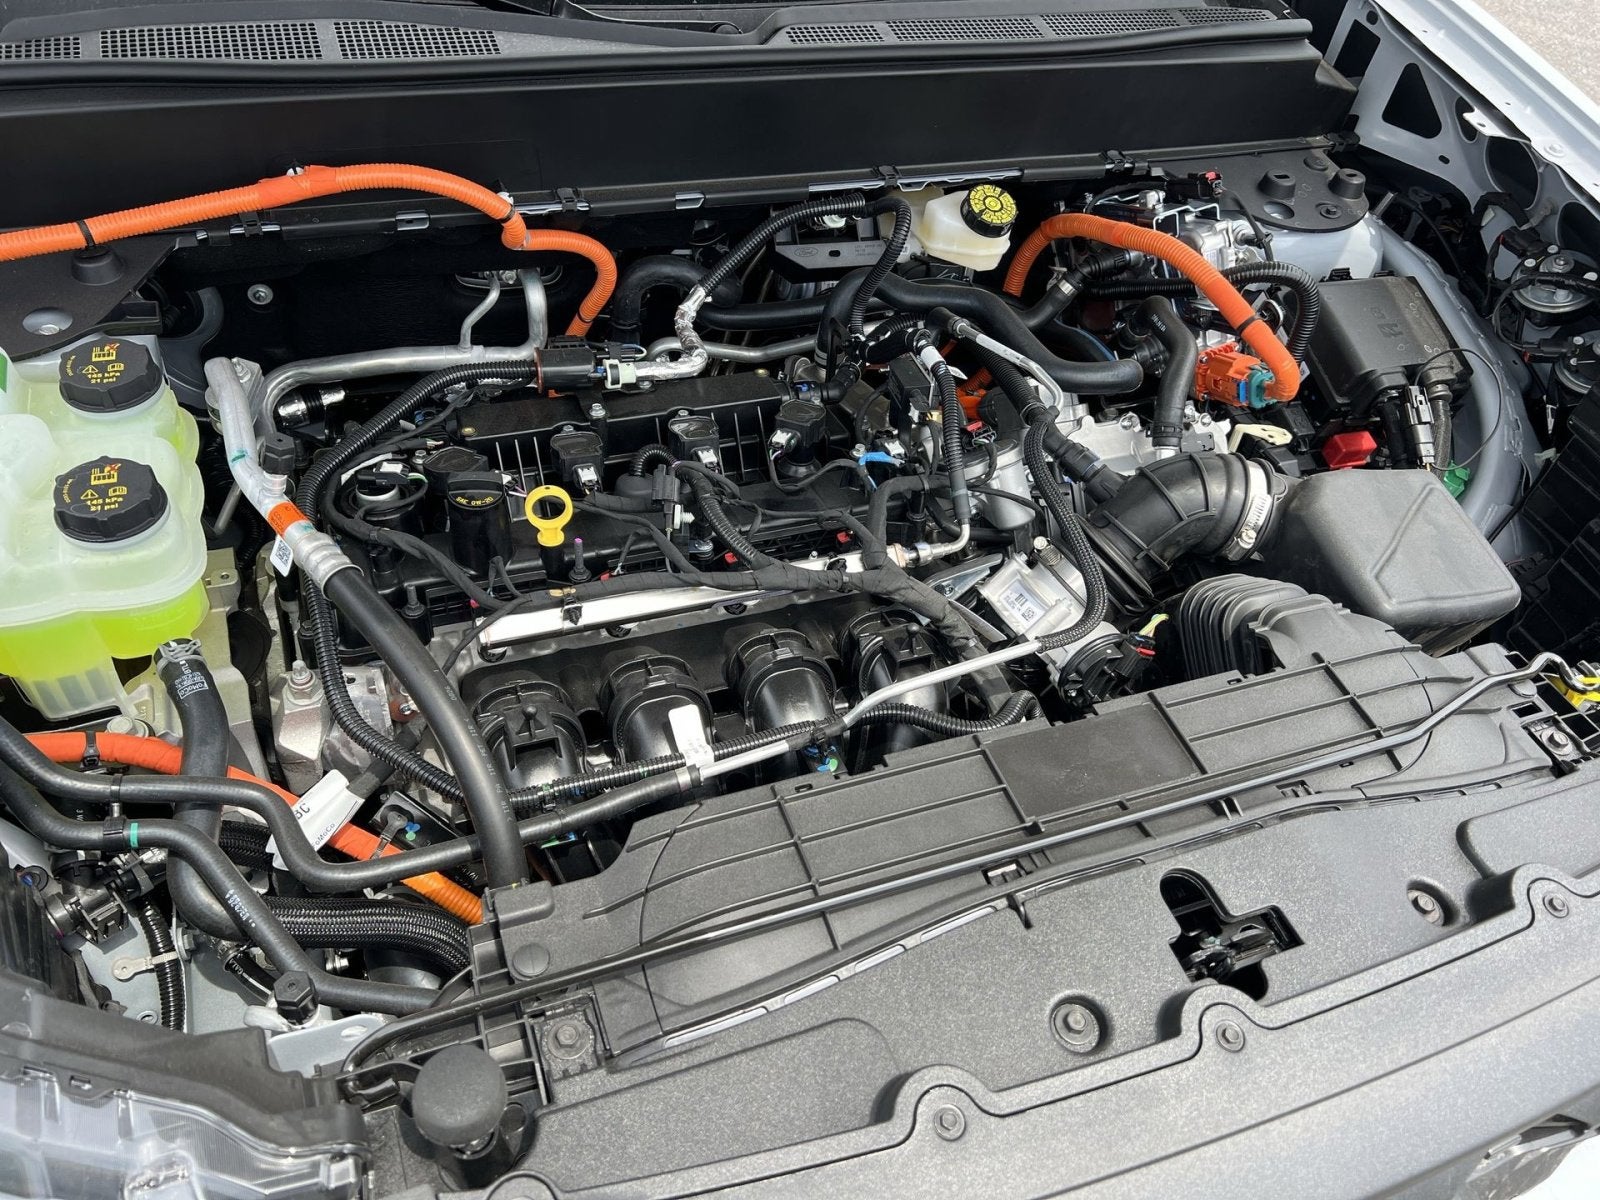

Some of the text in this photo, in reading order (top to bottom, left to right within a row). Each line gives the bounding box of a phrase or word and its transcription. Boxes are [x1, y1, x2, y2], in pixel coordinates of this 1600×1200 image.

[456, 496, 494, 506] SAE 0W-20
[104, 503, 119, 511] psi
